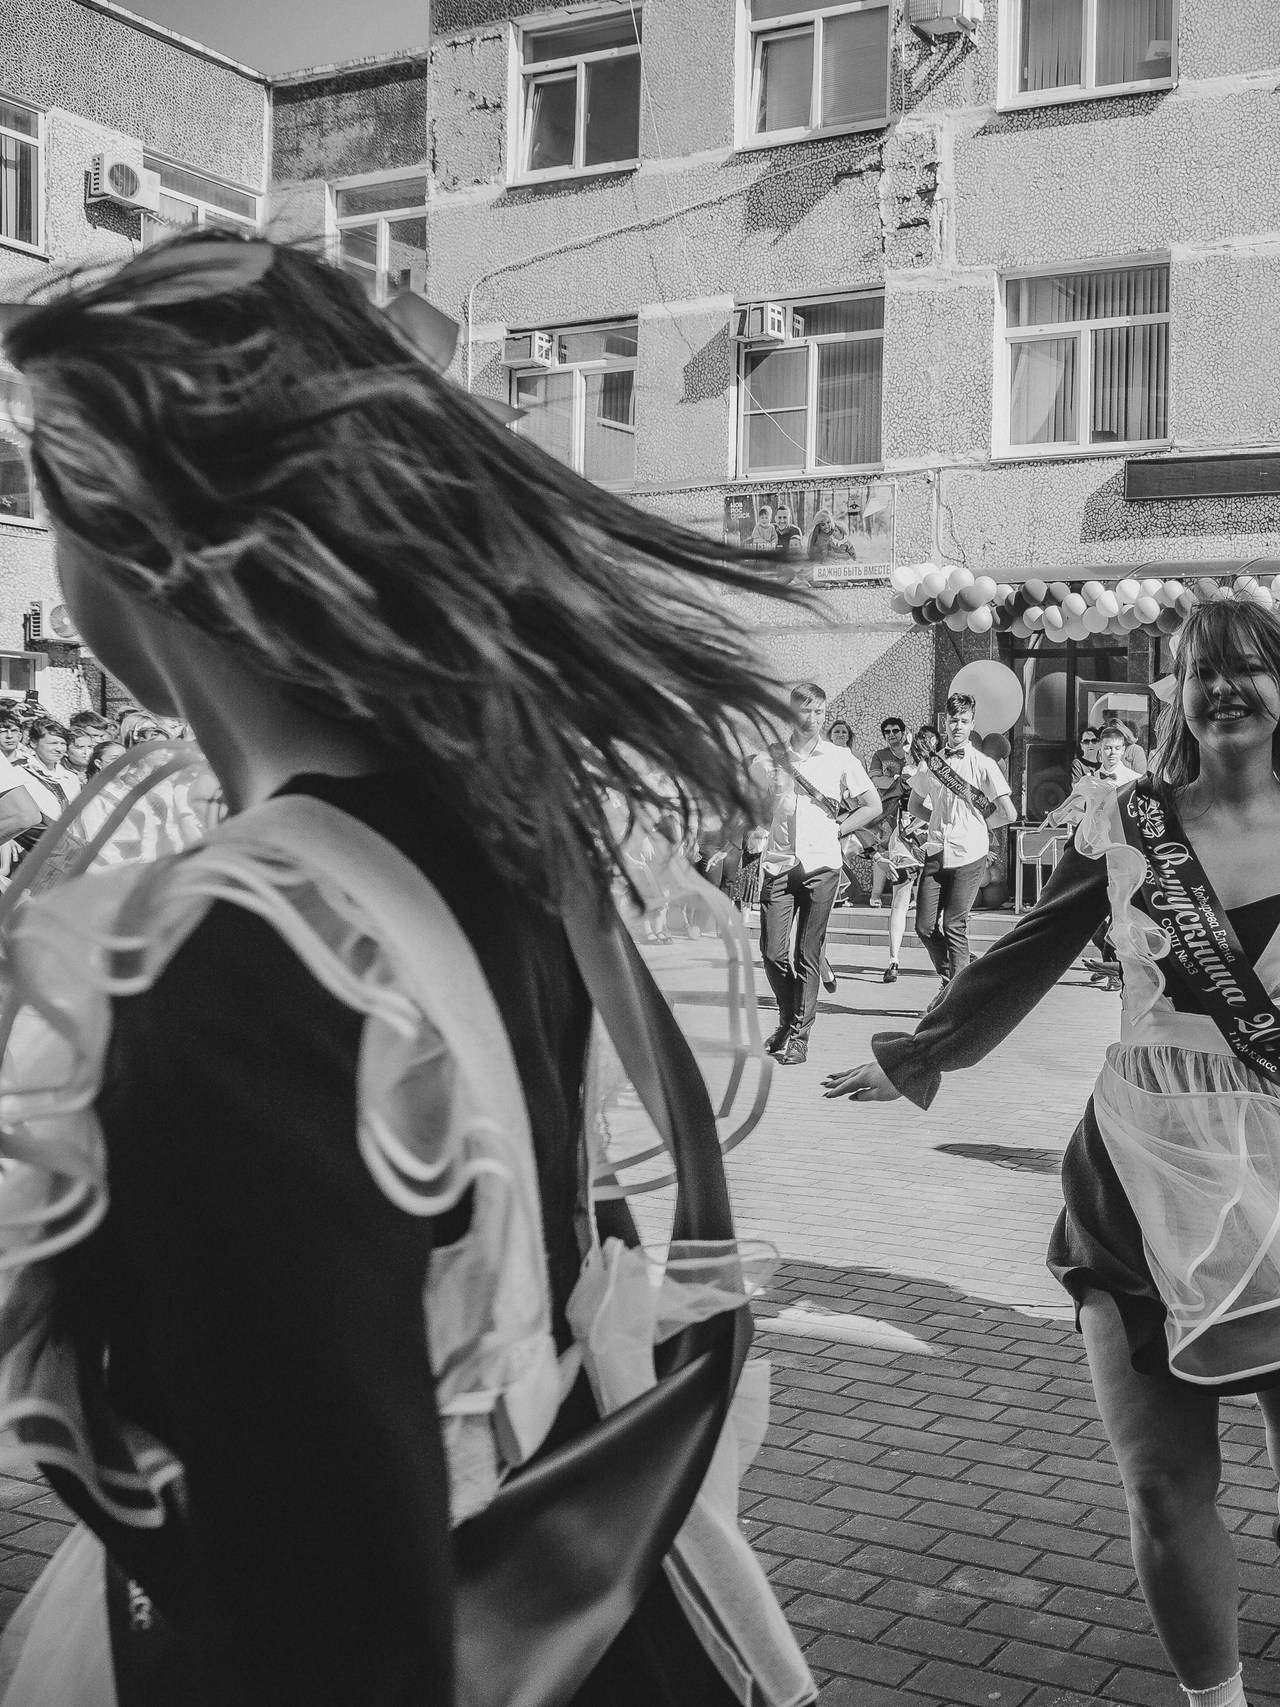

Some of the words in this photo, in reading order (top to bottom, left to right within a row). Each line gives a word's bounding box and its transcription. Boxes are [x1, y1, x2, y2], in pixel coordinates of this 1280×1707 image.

[818, 567, 841, 577] ВАЖНО
[843, 566, 862, 576] БЫТЬ
[864, 564, 891, 575] ВМЕСТЕ
[1150, 842, 1247, 1007] Выпускница
[1191, 885, 1220, 930] Ходырева
[1212, 929, 1236, 964] Елена
[1174, 948, 1199, 975] №33
[1248, 1050, 1278, 1073] класс
